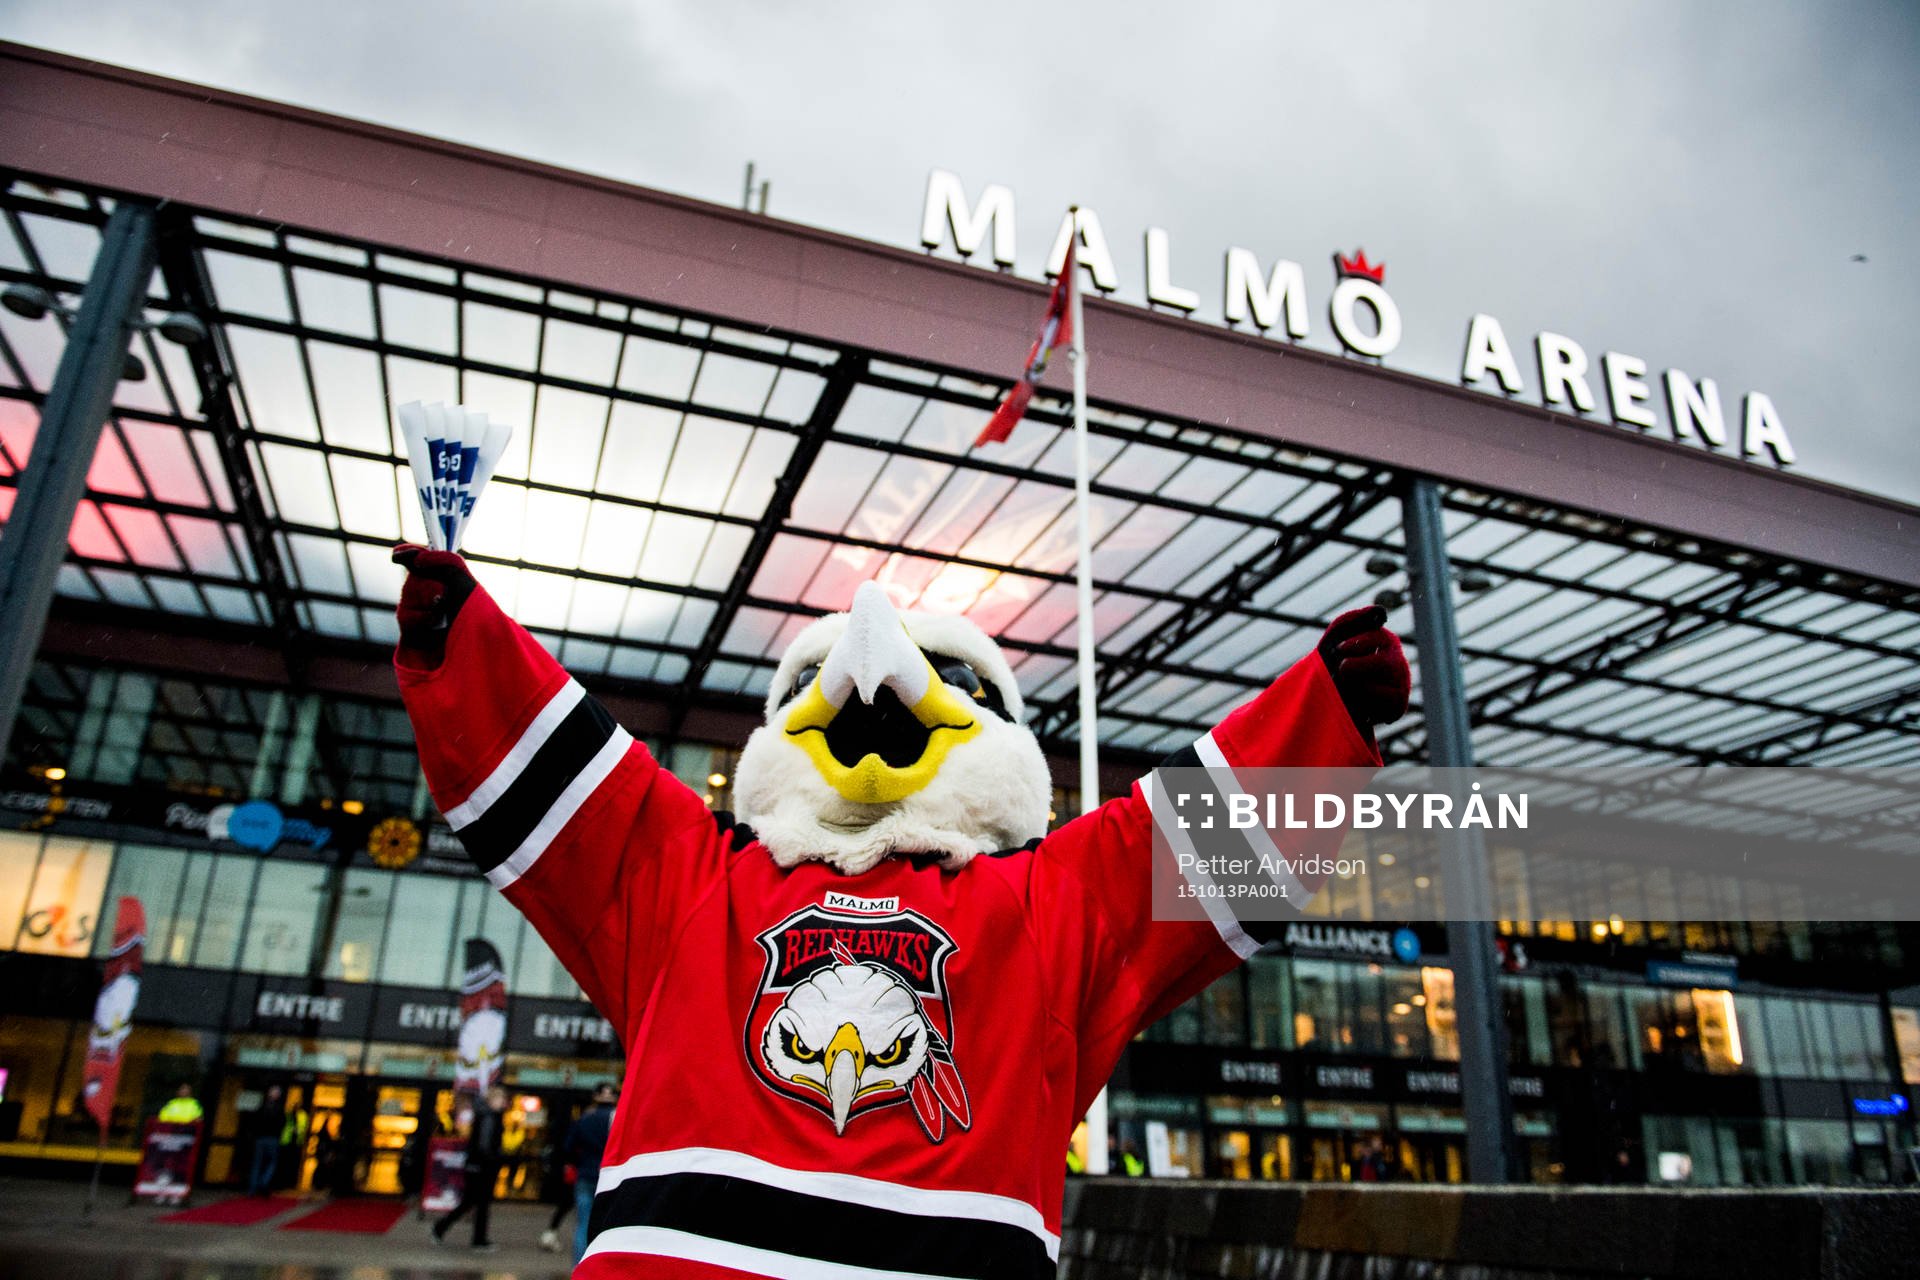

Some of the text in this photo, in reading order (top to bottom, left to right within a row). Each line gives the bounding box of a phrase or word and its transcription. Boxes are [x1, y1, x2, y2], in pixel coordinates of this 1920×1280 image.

[1461, 312, 1796, 466] ARENA
[829, 894, 895, 911] MALMÖ
[781, 928, 931, 982] REDHAWKS
[1284, 922, 1393, 956] ALLIANCE
